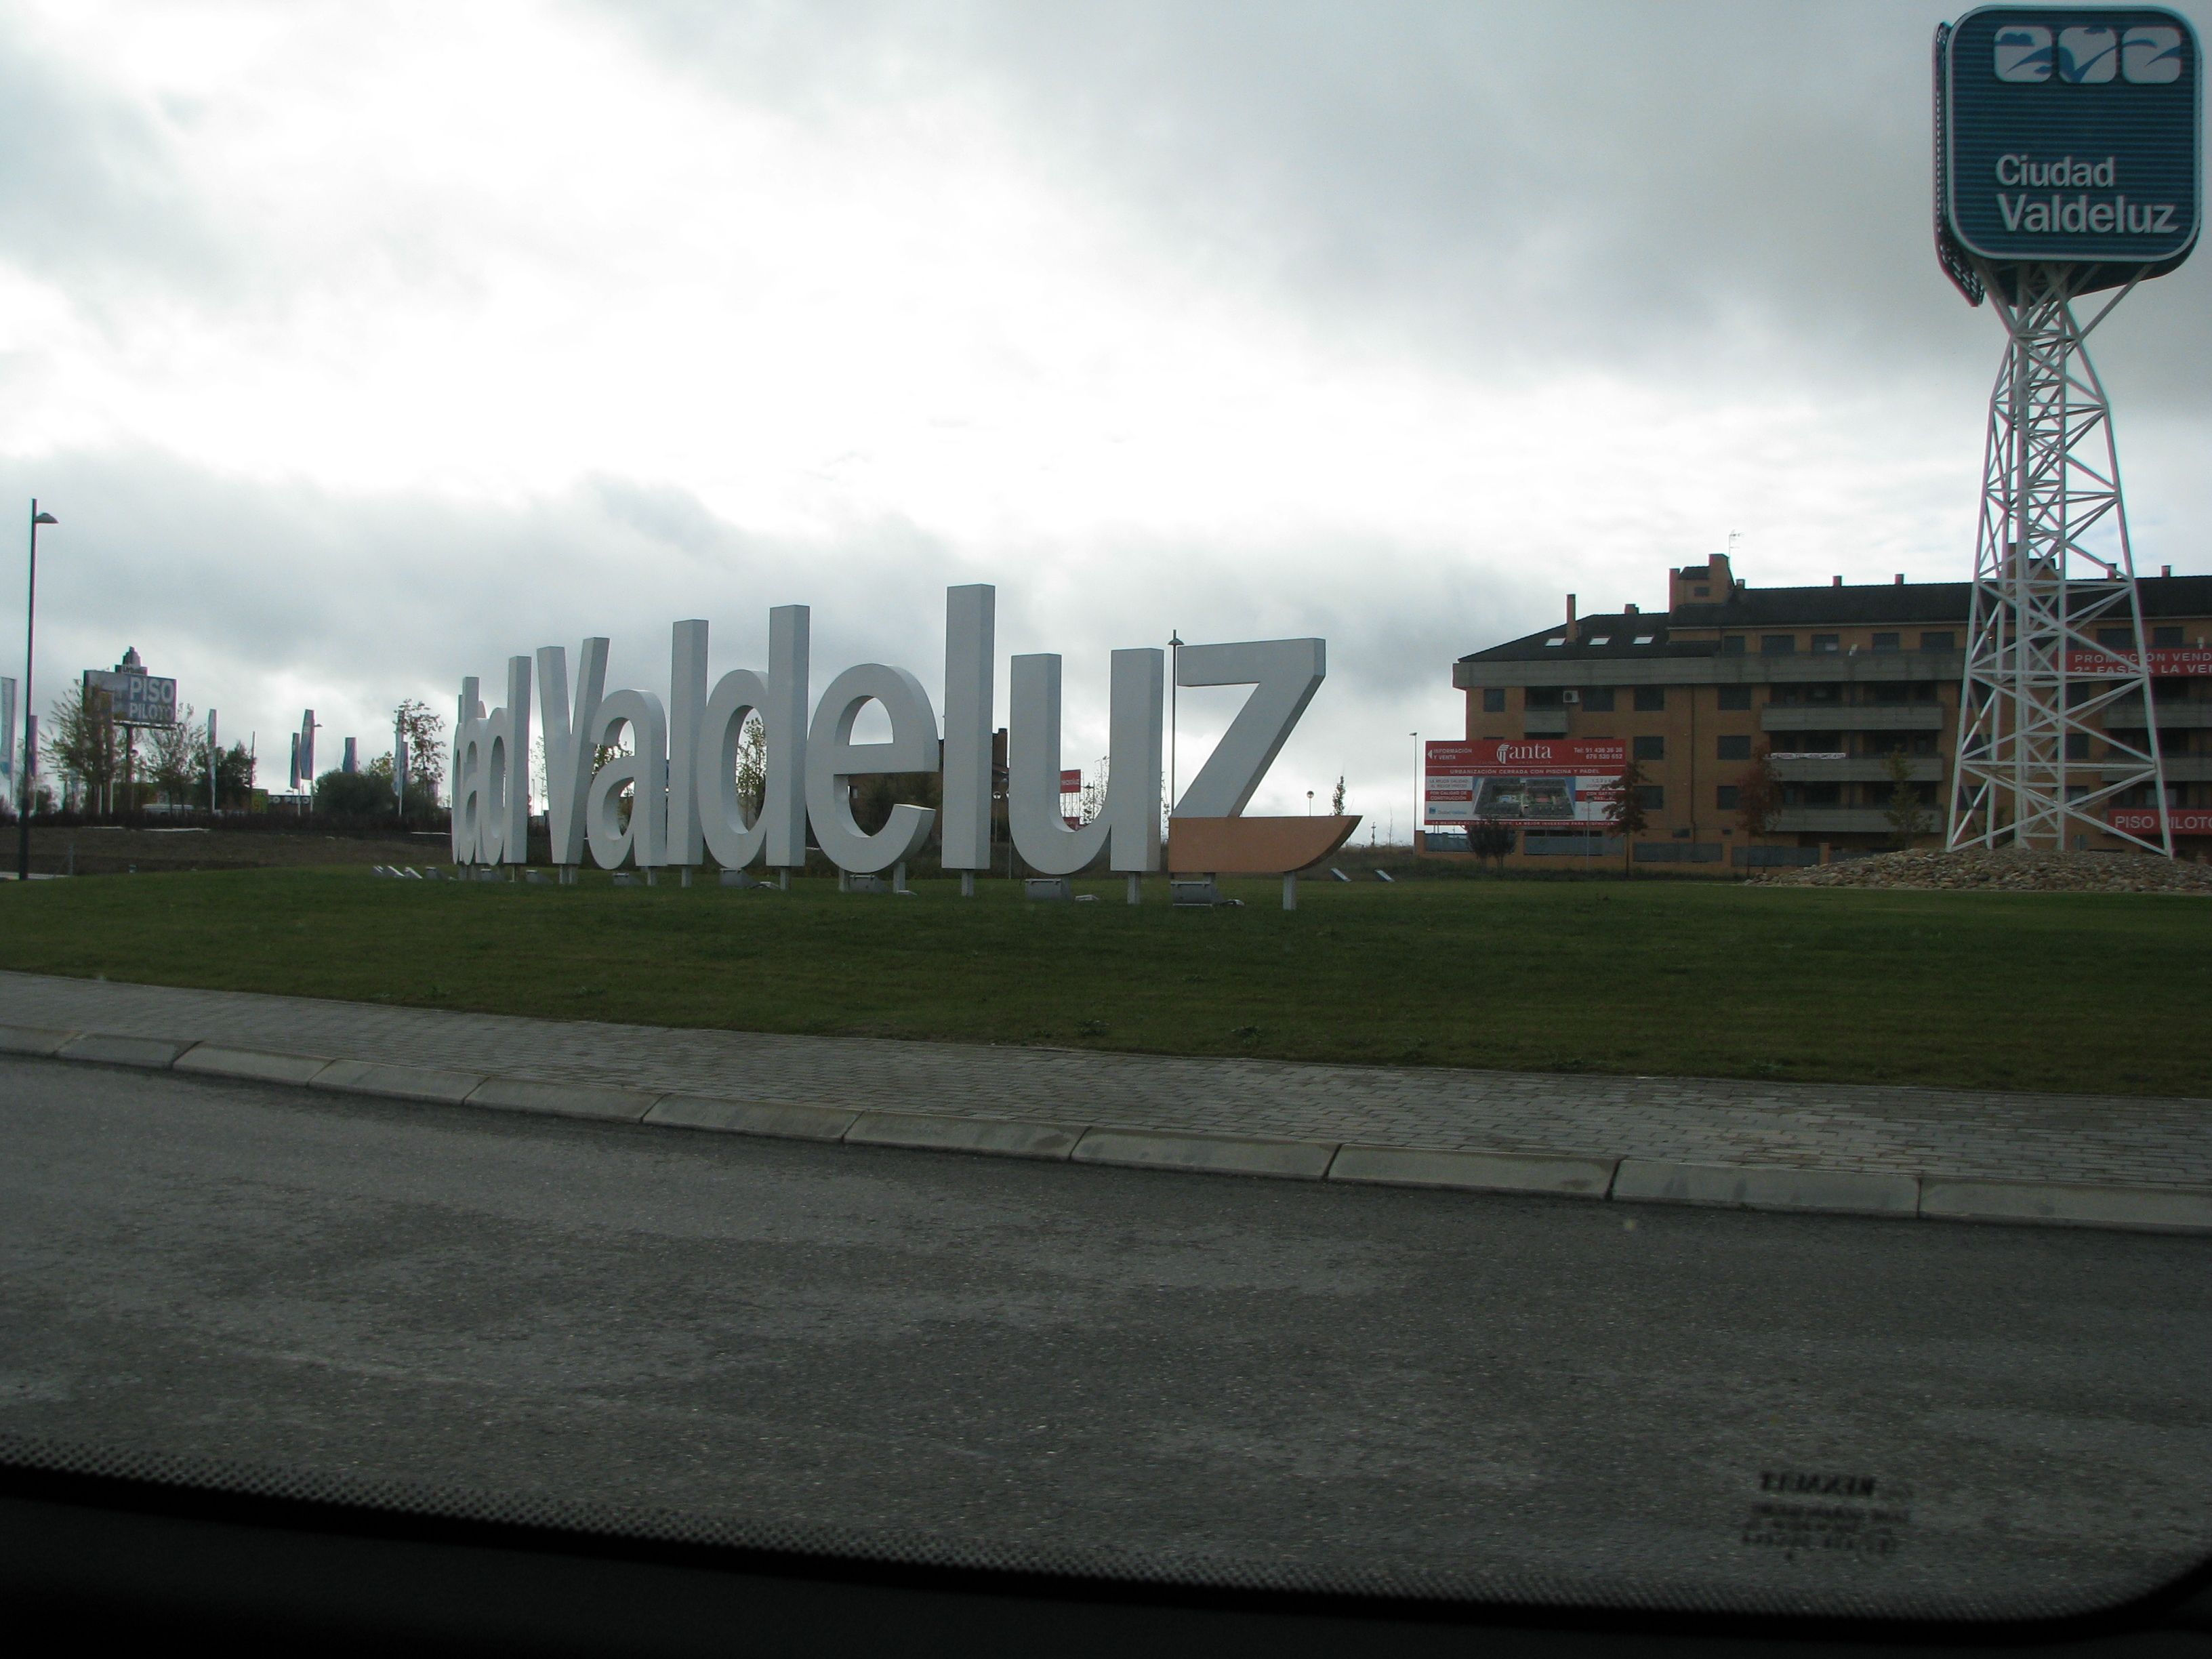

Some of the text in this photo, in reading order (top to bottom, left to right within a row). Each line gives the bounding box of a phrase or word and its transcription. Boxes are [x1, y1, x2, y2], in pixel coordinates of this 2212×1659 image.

[1995, 154, 2114, 188] Ciudad
[1996, 193, 2179, 234] Valdeluz
[2160, 664, 2180, 674] LA
[129, 676, 175, 703] PISO
[129, 702, 175, 721] PILOTO
[537, 584, 1362, 874] Valdeluz
[2114, 815, 2212, 829] PISO ILOT
